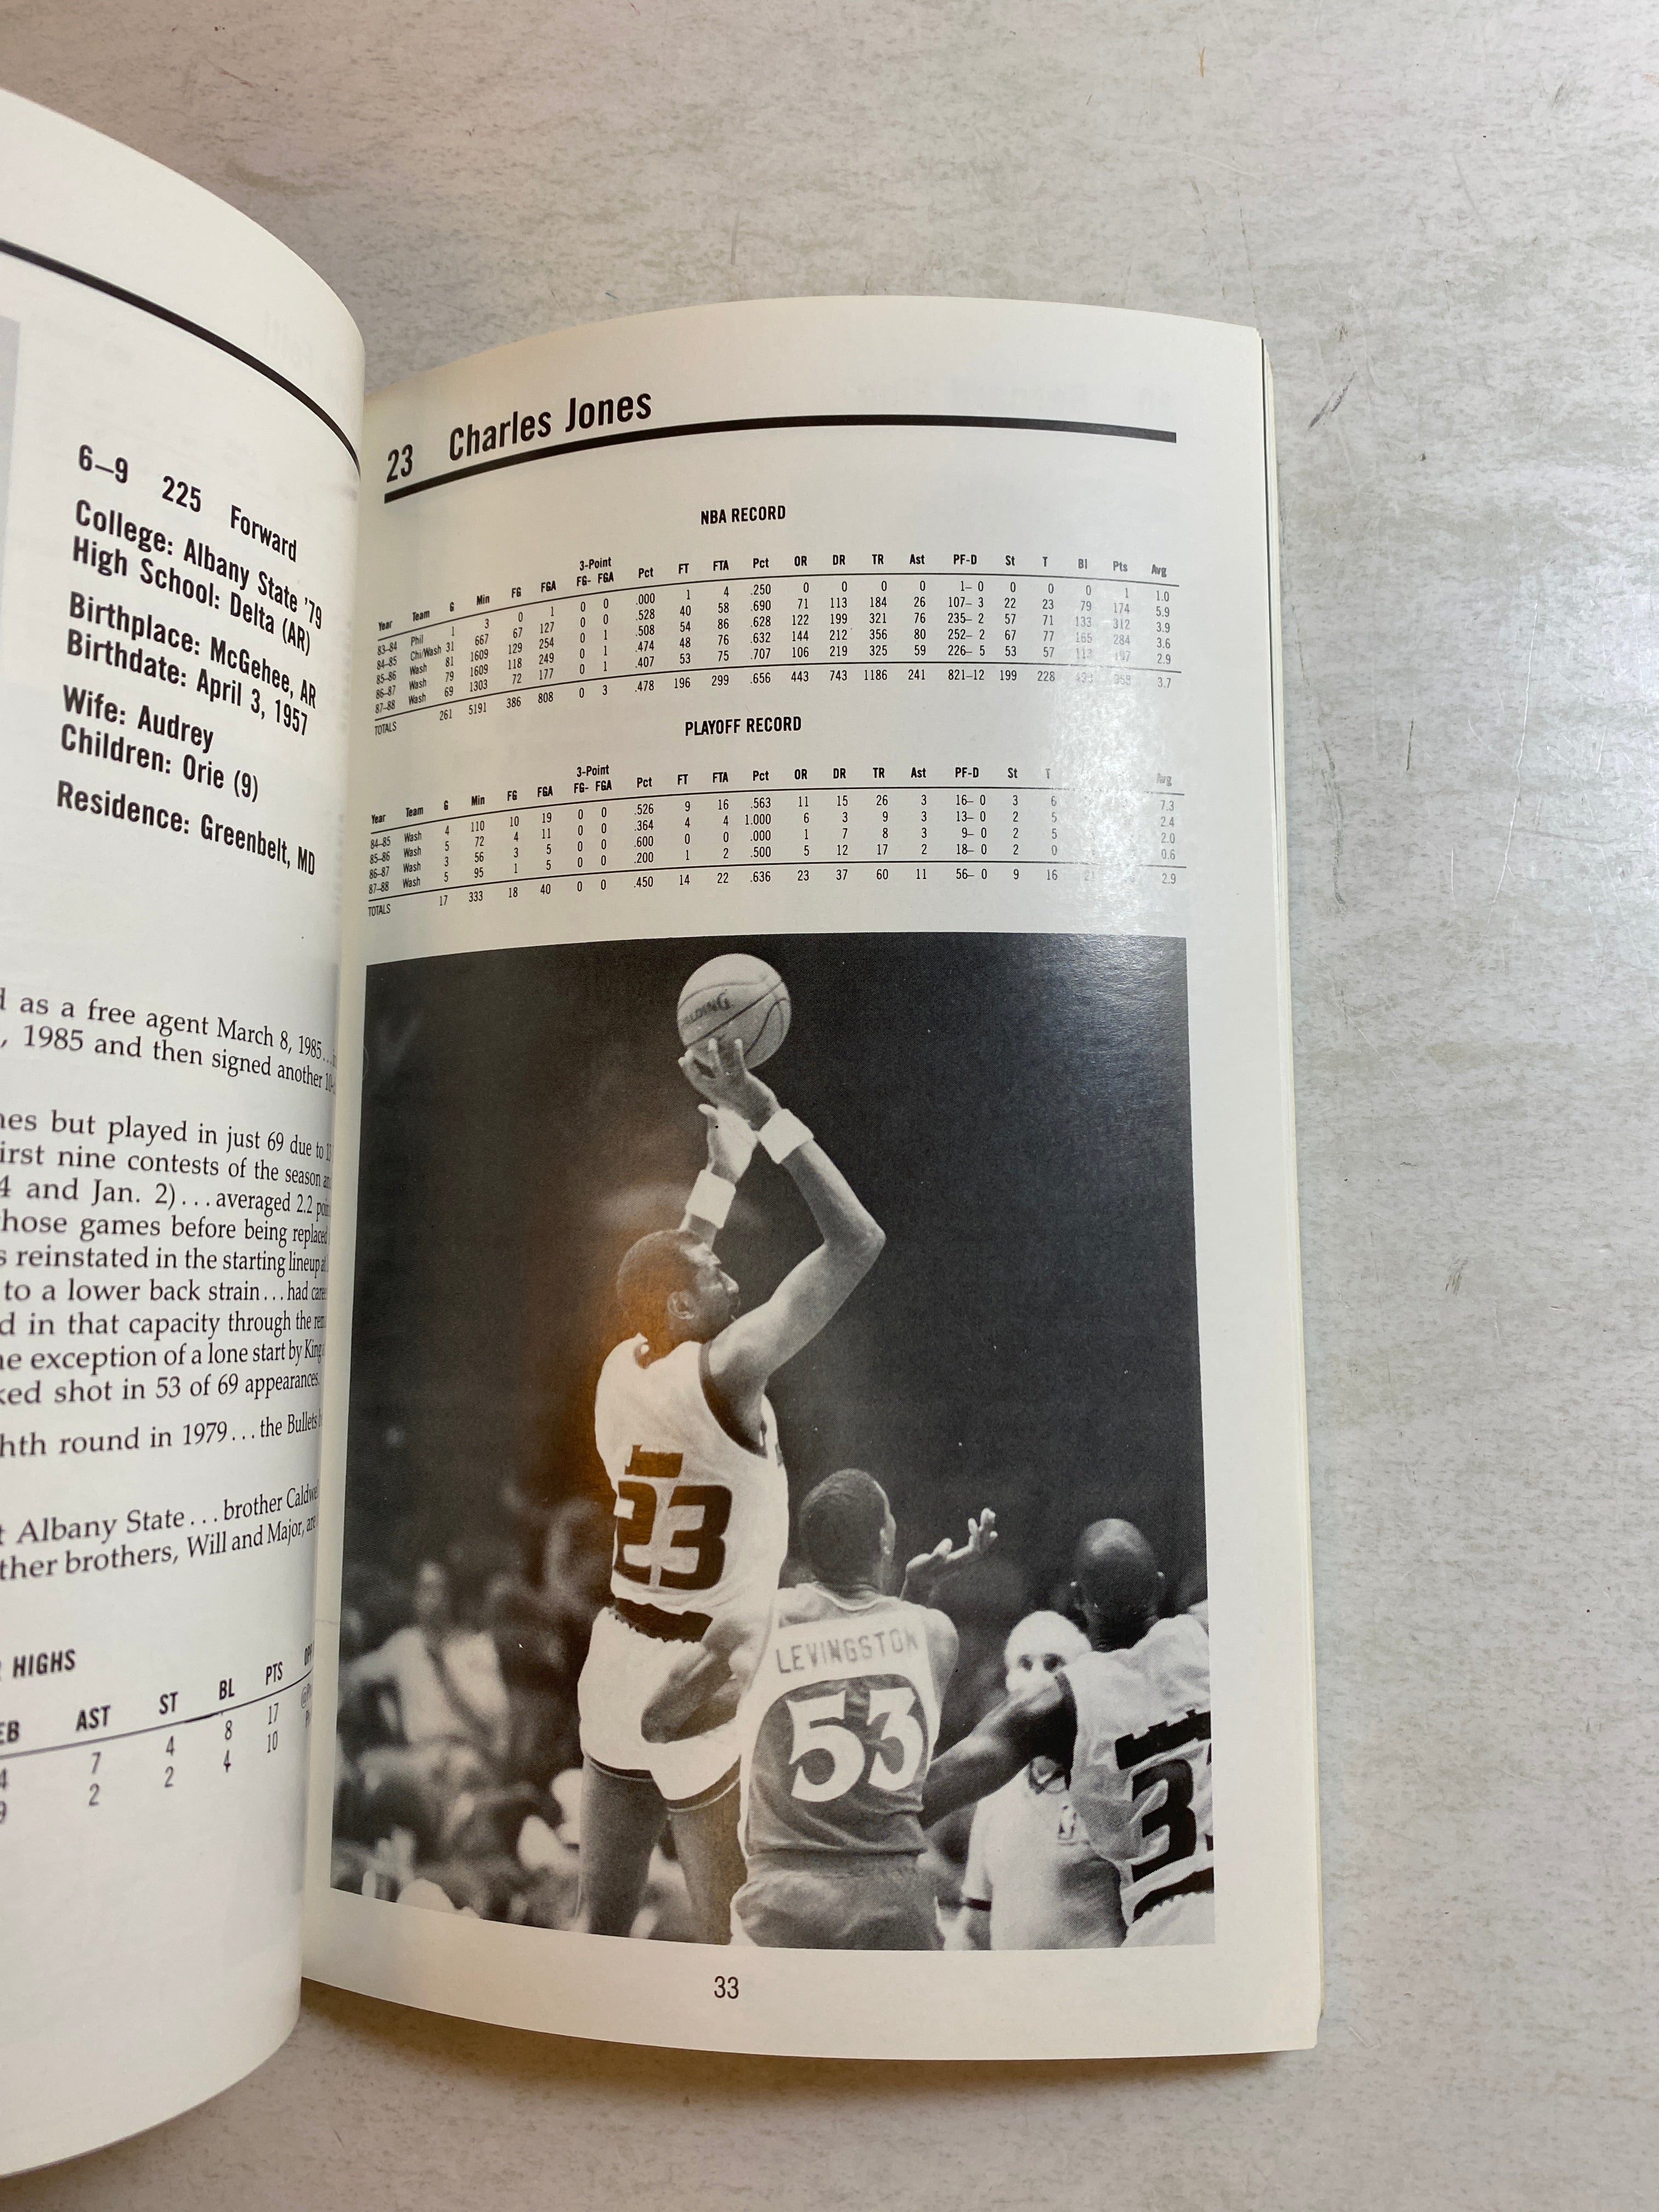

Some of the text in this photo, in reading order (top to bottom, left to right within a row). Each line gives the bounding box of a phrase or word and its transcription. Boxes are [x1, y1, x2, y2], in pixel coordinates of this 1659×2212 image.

[387, 393, 651, 483] 23 Charles Jones
[162, 476, 201, 512] 225
[231, 505, 296, 562] Forward
[701, 505, 785, 525] NBA RECORD
[76, 500, 172, 555] College:
[184, 538, 249, 590] Albany
[258, 571, 297, 612] State
[580, 557, 611, 571] 3-Point
[74, 535, 309, 656] High School: Delta (AR)
[379, 621, 392, 631] Year
[413, 611, 430, 621] Team
[450, 602, 454, 612] G
[477, 595, 489, 605] Min
[512, 587, 521, 598] FG
[541, 580, 556, 592] FGA
[598, 572, 614, 584] FGA
[639, 567, 653, 578] Pct
[679, 563, 689, 574] FT
[713, 560, 729, 571] FTA
[753, 558, 769, 568] Pct
[794, 556, 807, 566] OR
[833, 555, 845, 565] DR
[872, 554, 883, 565] TR
[910, 554, 924, 564] Ast
[953, 554, 977, 565] PF-D
[1006, 555, 1015, 566] St
[1042, 557, 1048, 567] T
[1079, 558, 1087, 569] Bl
[1113, 561, 1127, 572] Pts
[1152, 565, 1166, 577] Avg
[69, 591, 315, 709] Birthplace: McGehee, AR
[410, 663, 427, 675] Wash
[445, 656, 453, 667] 81
[471, 649, 488, 662] 1609
[509, 642, 522, 654] 129
[539, 637, 554, 649] 254
[580, 633, 585, 643] 0
[604, 630, 607, 640] 1
[636, 624, 654, 636] .508
[680, 621, 691, 632] 54
[718, 618, 729, 629] 86
[751, 616, 771, 627] .628
[793, 614, 809, 625] 122
[831, 613, 847, 624] 199
[870, 613, 886, 623] 321
[915, 613, 926, 623] 76
[1005, 614, 1015, 624] 57
[1043, 615, 1053, 625] 71
[1156, 622, 1170, 633] 3.9
[67, 628, 307, 736] Birthdate: April 3, 1957
[64, 685, 213, 753] Wife: Audrey
[686, 716, 801, 736] PLAYOFF RECORD
[62, 724, 258, 802] Children: Orie (9)
[58, 781, 314, 875] Residence: Greenbelt, MD
[368, 904, 390, 916] TOTALS
[440, 895, 448, 906] 17
[469, 891, 483, 902] 333
[509, 887, 517, 898] 18
[540, 884, 550, 894] 40
[577, 881, 582, 891] 0
[601, 879, 606, 890] 0
[634, 876, 653, 888] .450
[680, 874, 690, 885] 14
[718, 872, 729, 883] 22
[751, 871, 770, 882] .636
[798, 870, 809, 881] 23
[837, 869, 848, 880] 37
[877, 869, 888, 879] 60
[917, 869, 926, 879] 11
[1014, 869, 1019, 879] 9
[1047, 870, 1058, 880] 16
[1163, 873, 1176, 884] 2.9
[20, 998, 291, 1054] as a free agent March 8,
[52, 1110, 323, 1159] but played in just 69 due to
[31, 1339, 322, 1375] exception of a lone start by King
[55, 1373, 320, 1402] shot in 53 of 69 appearances.
[66, 1519, 304, 1573] brothers, Will and Major,
[613, 1480, 732, 1590] 23
[13, 1649, 75, 1678] HIGHS
[776, 1627, 919, 1674] LEVINGSTON
[76, 1662, 283, 1731] AST ST BL PTS
[89, 1731, 278, 1807] 2 2 4 10
[92, 1752, 101, 1774] 7
[166, 1736, 174, 1755] 4
[225, 1720, 232, 1740] 8
[268, 1702, 279, 1725] 17
[785, 1685, 924, 1802] 53
[714, 1976, 738, 1999] 33
